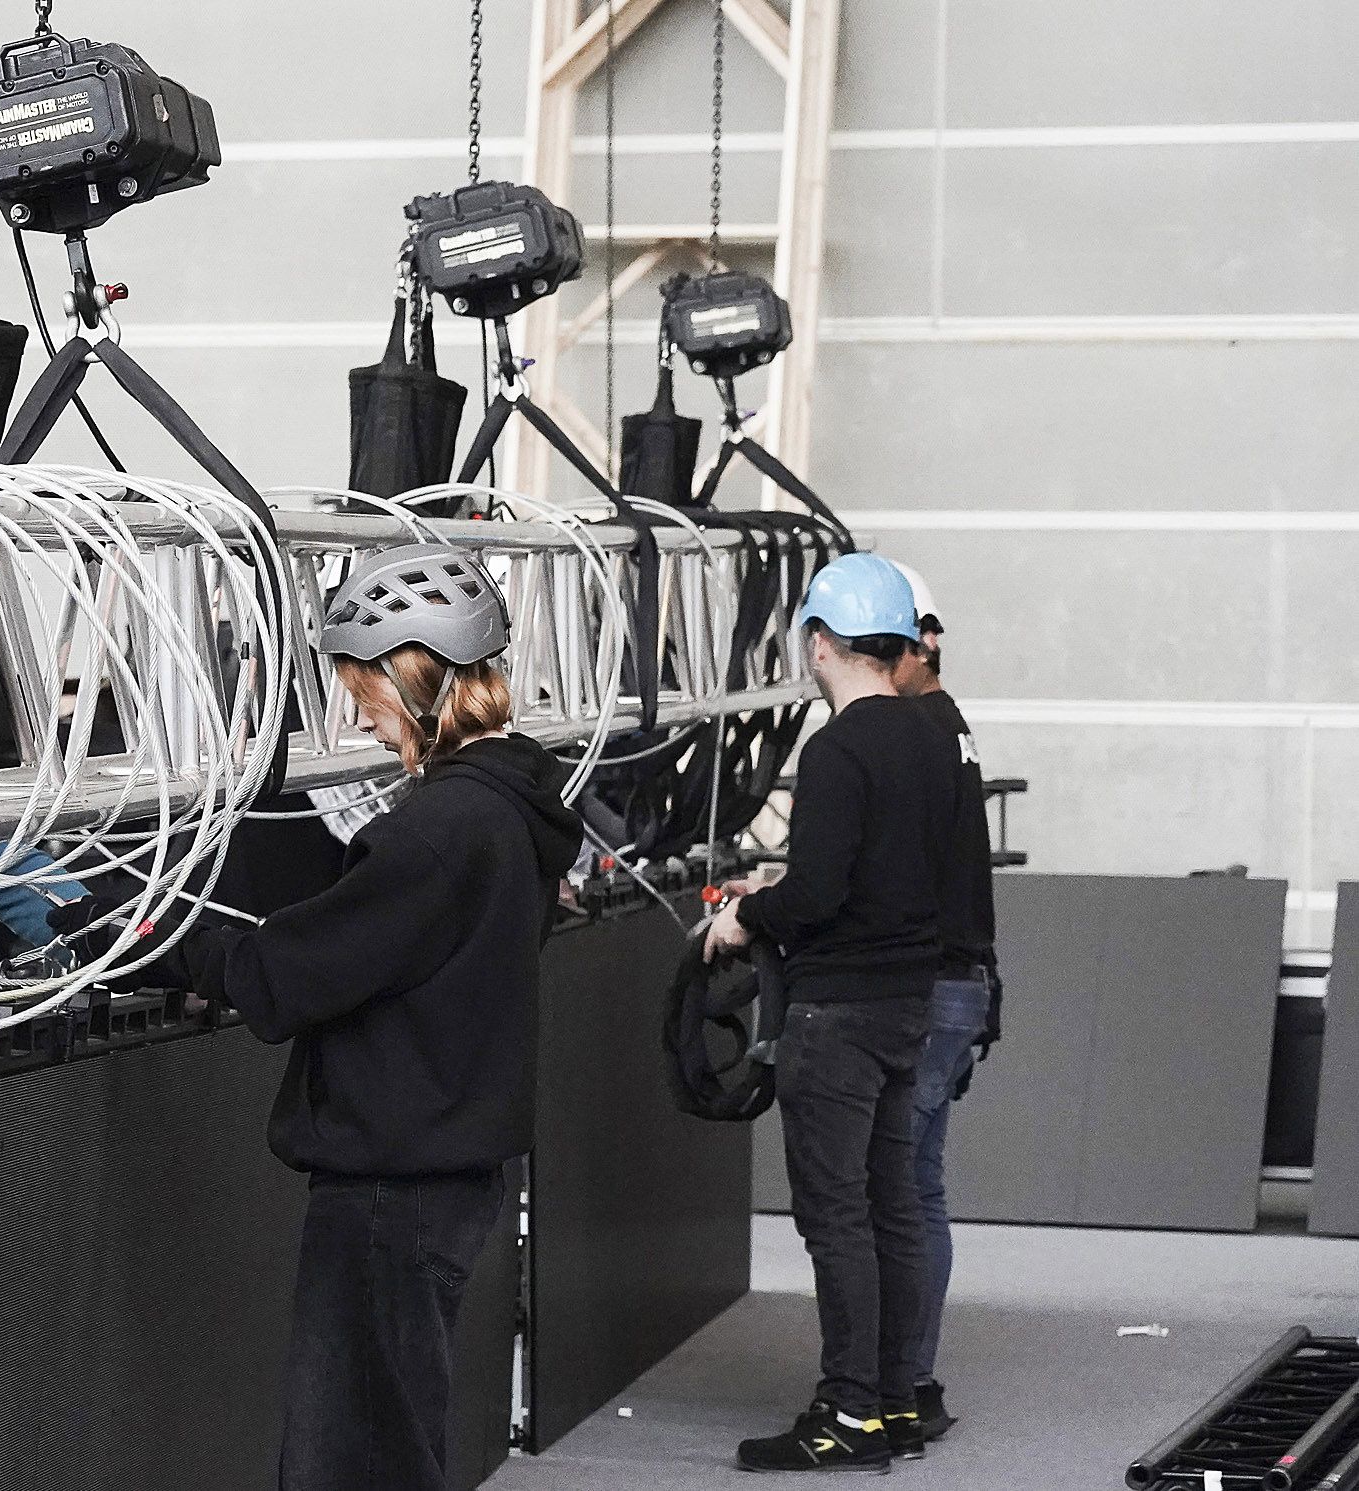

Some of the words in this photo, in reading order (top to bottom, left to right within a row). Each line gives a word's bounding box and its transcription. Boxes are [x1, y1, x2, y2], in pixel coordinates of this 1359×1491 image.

[57, 96, 67, 104] THE
[68, 91, 89, 101] WORLD
[57, 103, 66, 111] OF
[66, 98, 90, 109] MOTORS
[8, 134, 17, 142] OF
